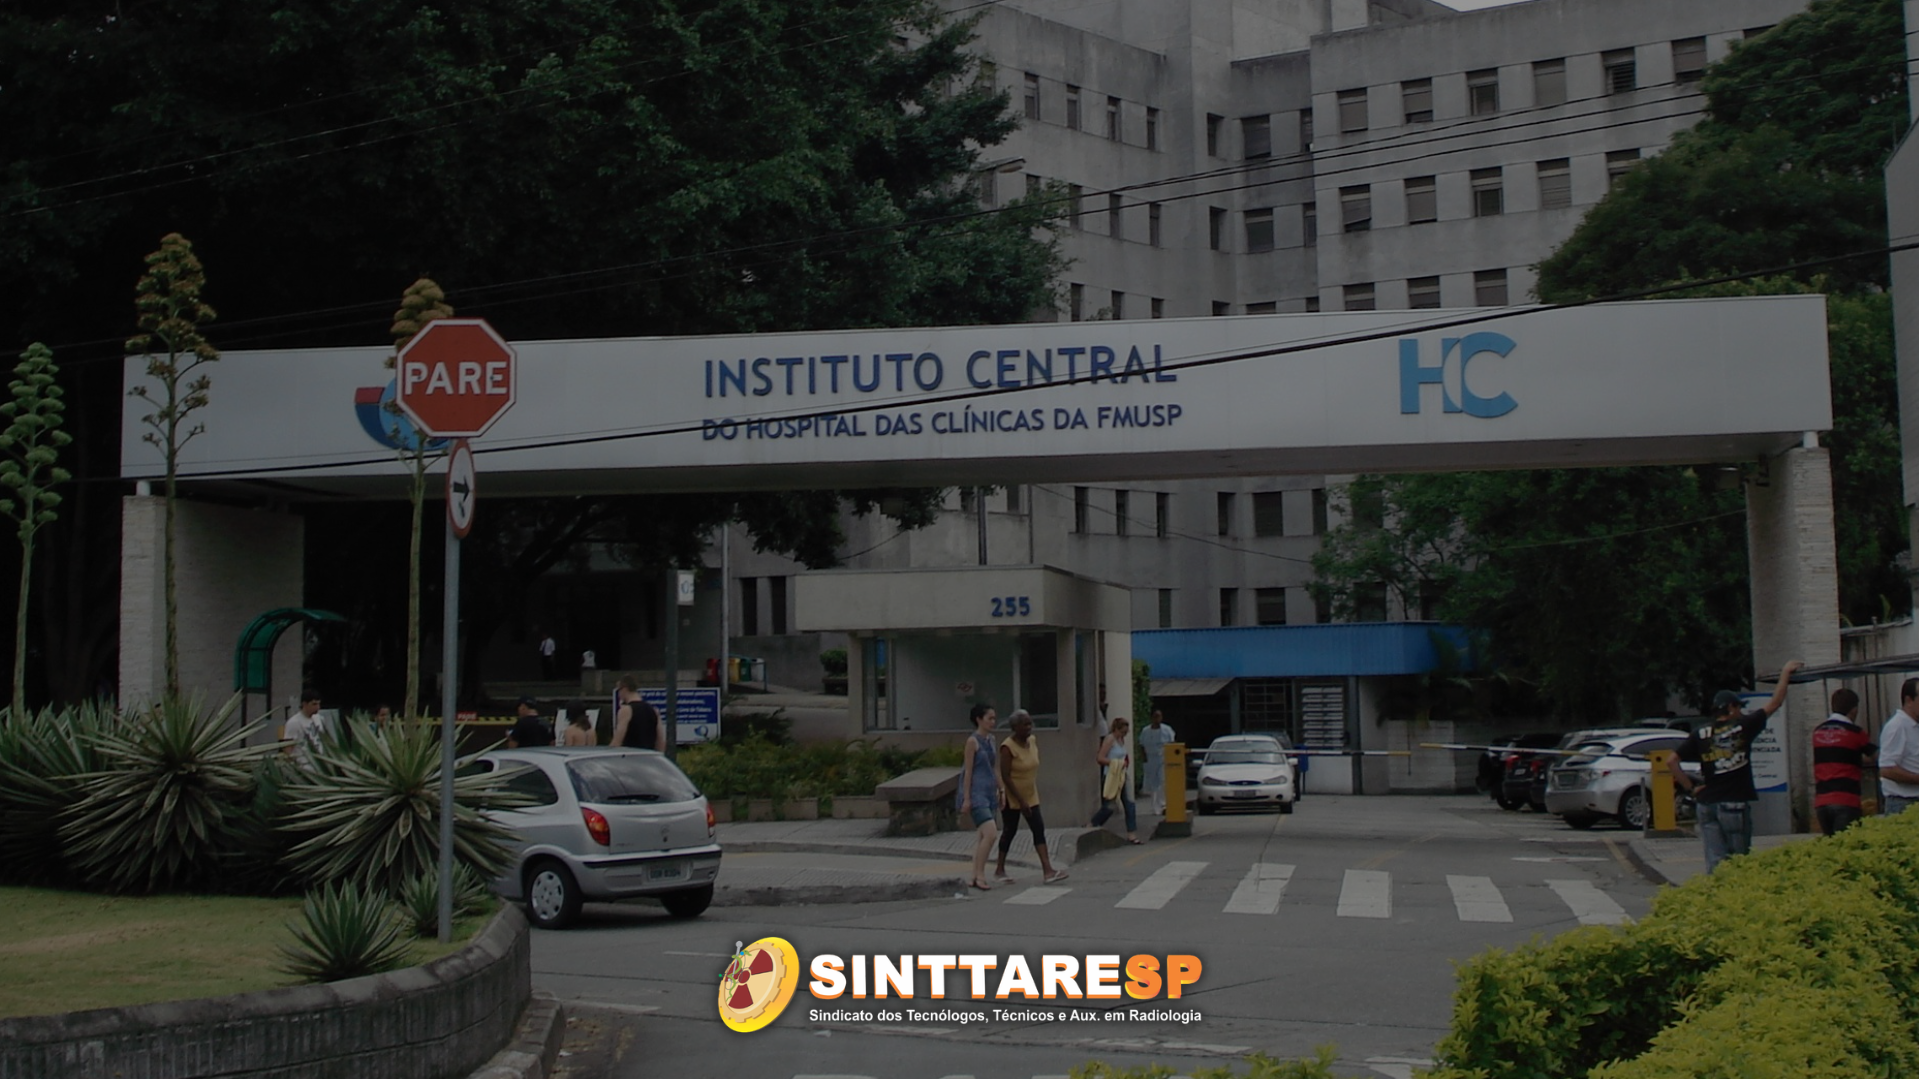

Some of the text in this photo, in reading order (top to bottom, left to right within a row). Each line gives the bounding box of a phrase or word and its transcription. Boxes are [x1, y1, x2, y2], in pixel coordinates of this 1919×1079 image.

[404, 361, 508, 395] PARE
[705, 344, 1177, 398] INSTITUTO CENTRAL
[1399, 331, 1519, 418] HC
[702, 404, 1182, 441] DO HOSPITAL DAS CLÍNICAS DA FMUSP
[991, 597, 1030, 617] 255
